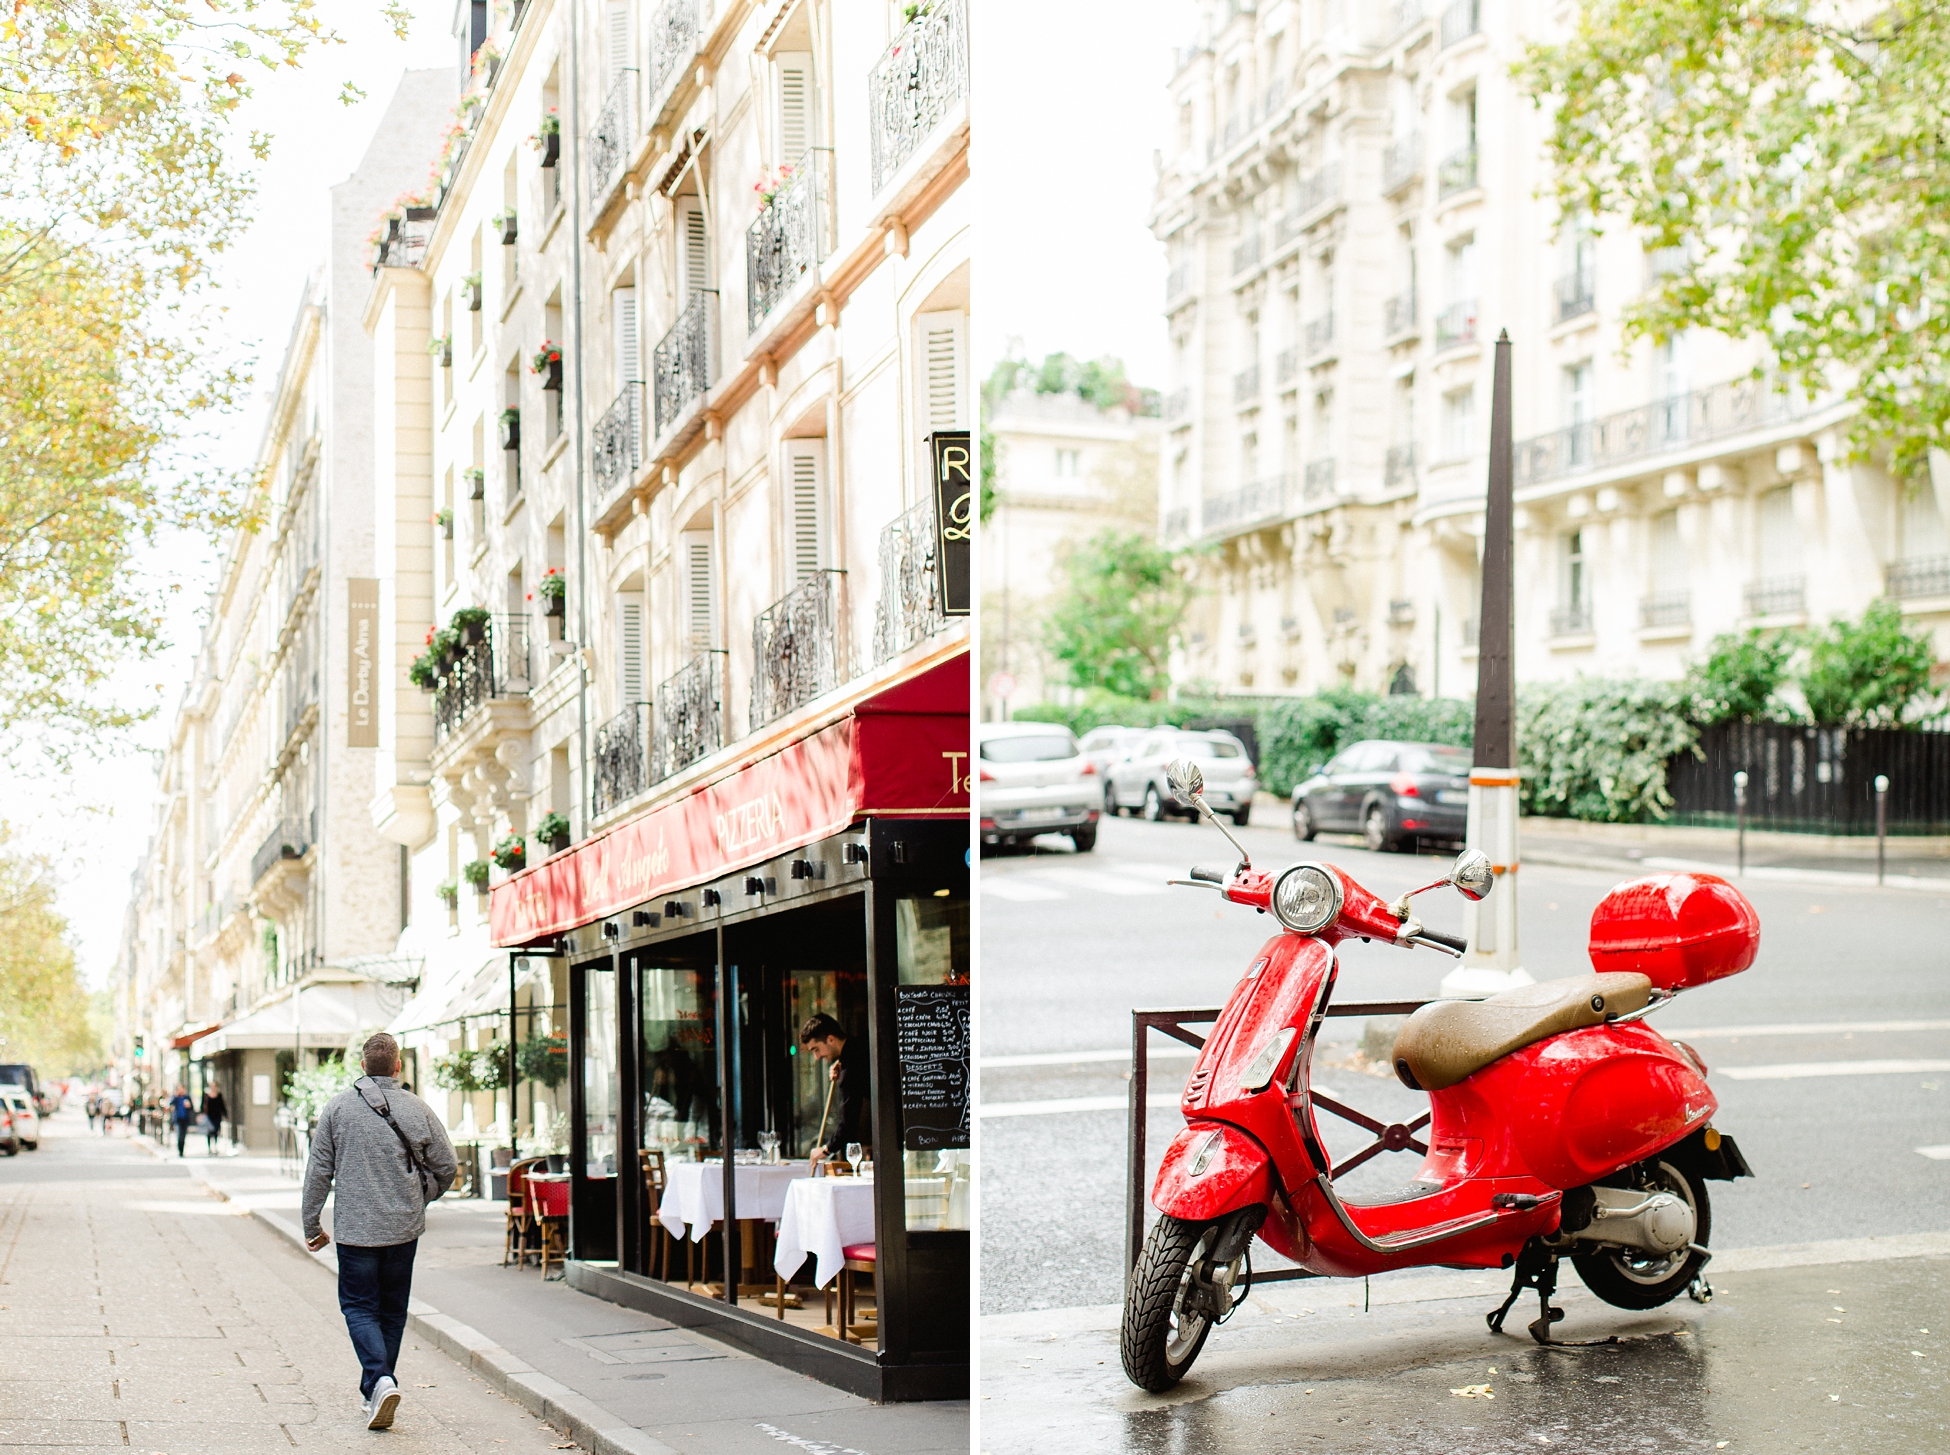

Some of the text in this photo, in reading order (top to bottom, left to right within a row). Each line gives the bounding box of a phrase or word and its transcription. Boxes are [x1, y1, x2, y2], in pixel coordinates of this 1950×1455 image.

[352, 618, 372, 726] Le Derby Alma
[716, 787, 787, 857] PIZZERIA
